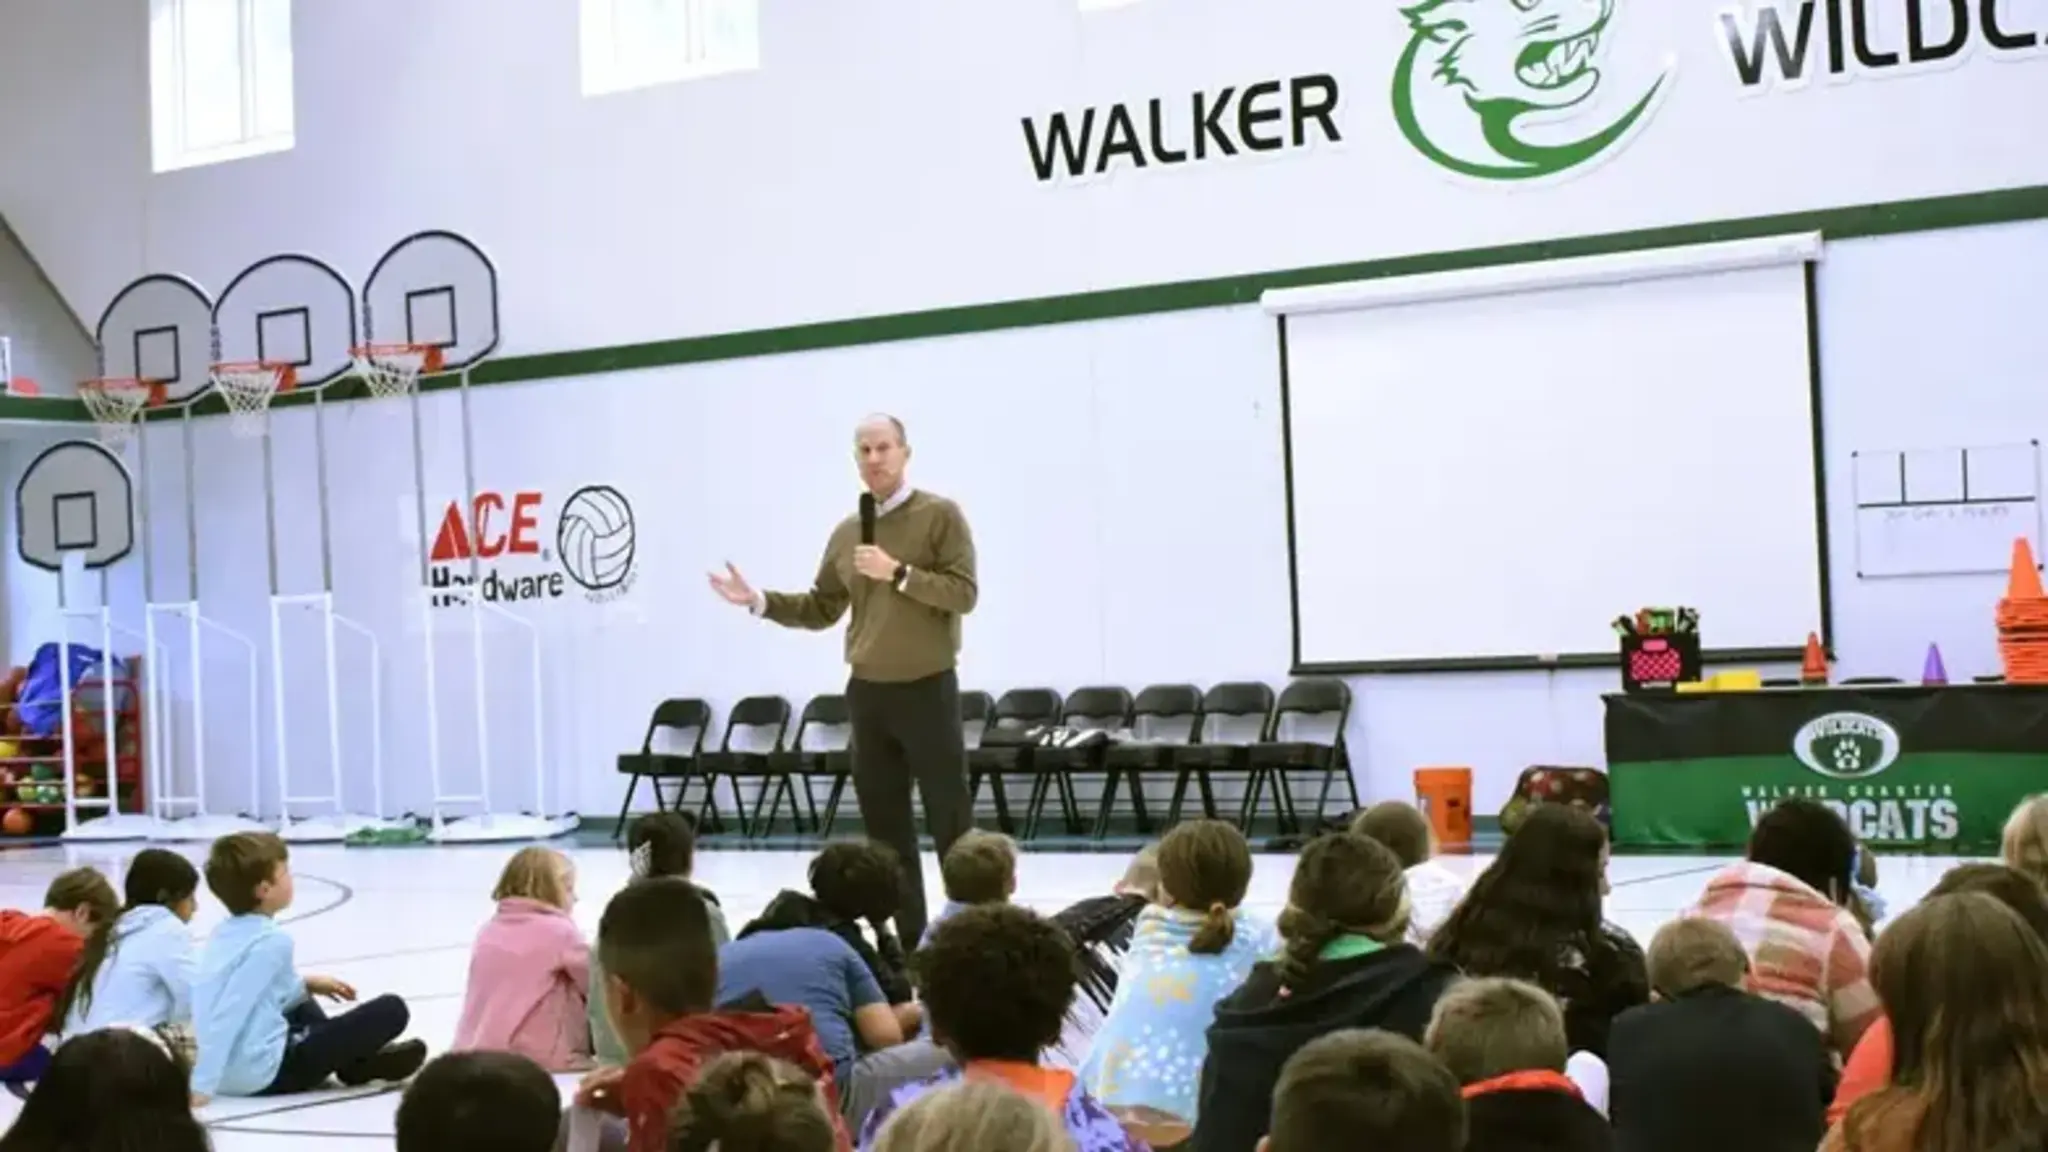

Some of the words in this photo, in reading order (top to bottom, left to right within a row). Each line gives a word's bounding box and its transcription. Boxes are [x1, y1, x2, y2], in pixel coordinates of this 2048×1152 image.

[1021, 73, 1342, 181] WALKER
[1720, 0, 2048, 86] WILDC
[430, 492, 543, 562] ACE
[431, 565, 564, 607] Hadware
[1745, 798, 1959, 840] WCATS
